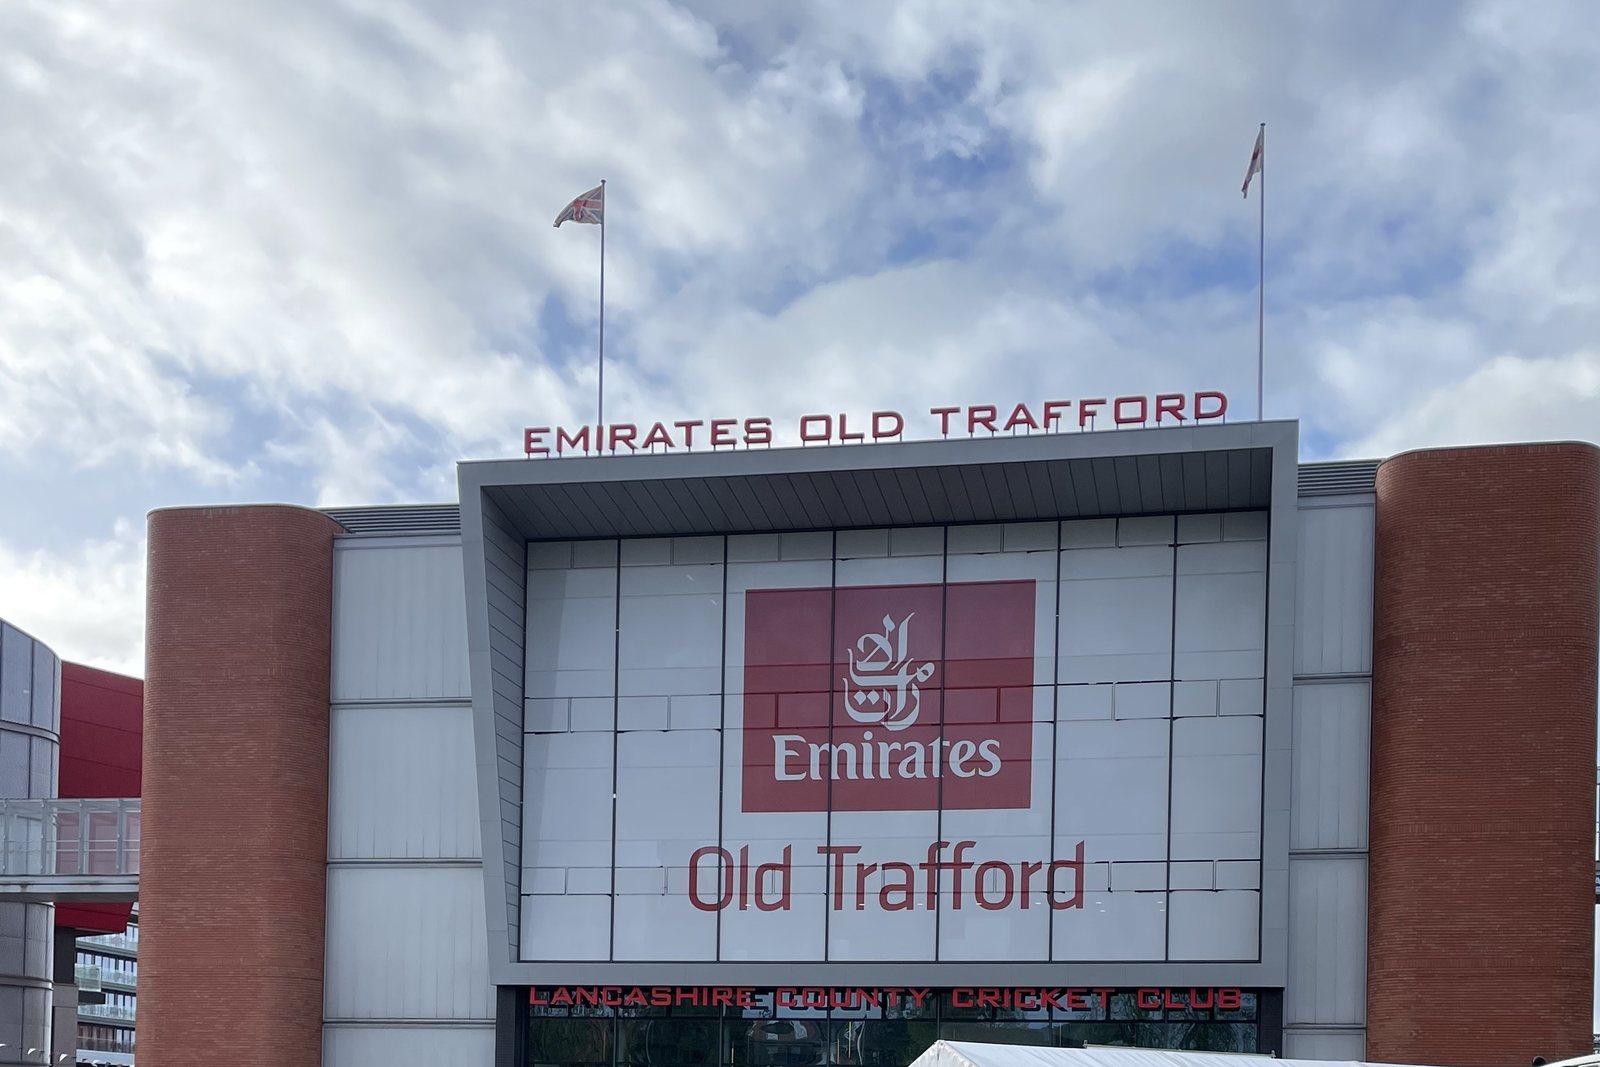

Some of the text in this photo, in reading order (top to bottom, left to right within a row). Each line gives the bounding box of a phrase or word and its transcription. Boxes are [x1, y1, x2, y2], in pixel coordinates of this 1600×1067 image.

[523, 391, 1228, 453] EMIRATES OLD TRAFFORD
[772, 731, 1002, 782] Emirates
[688, 840, 1085, 912] Old Trafford
[529, 986, 1241, 1009] LANCASHIRE COUNTY CRICKET CLUB
